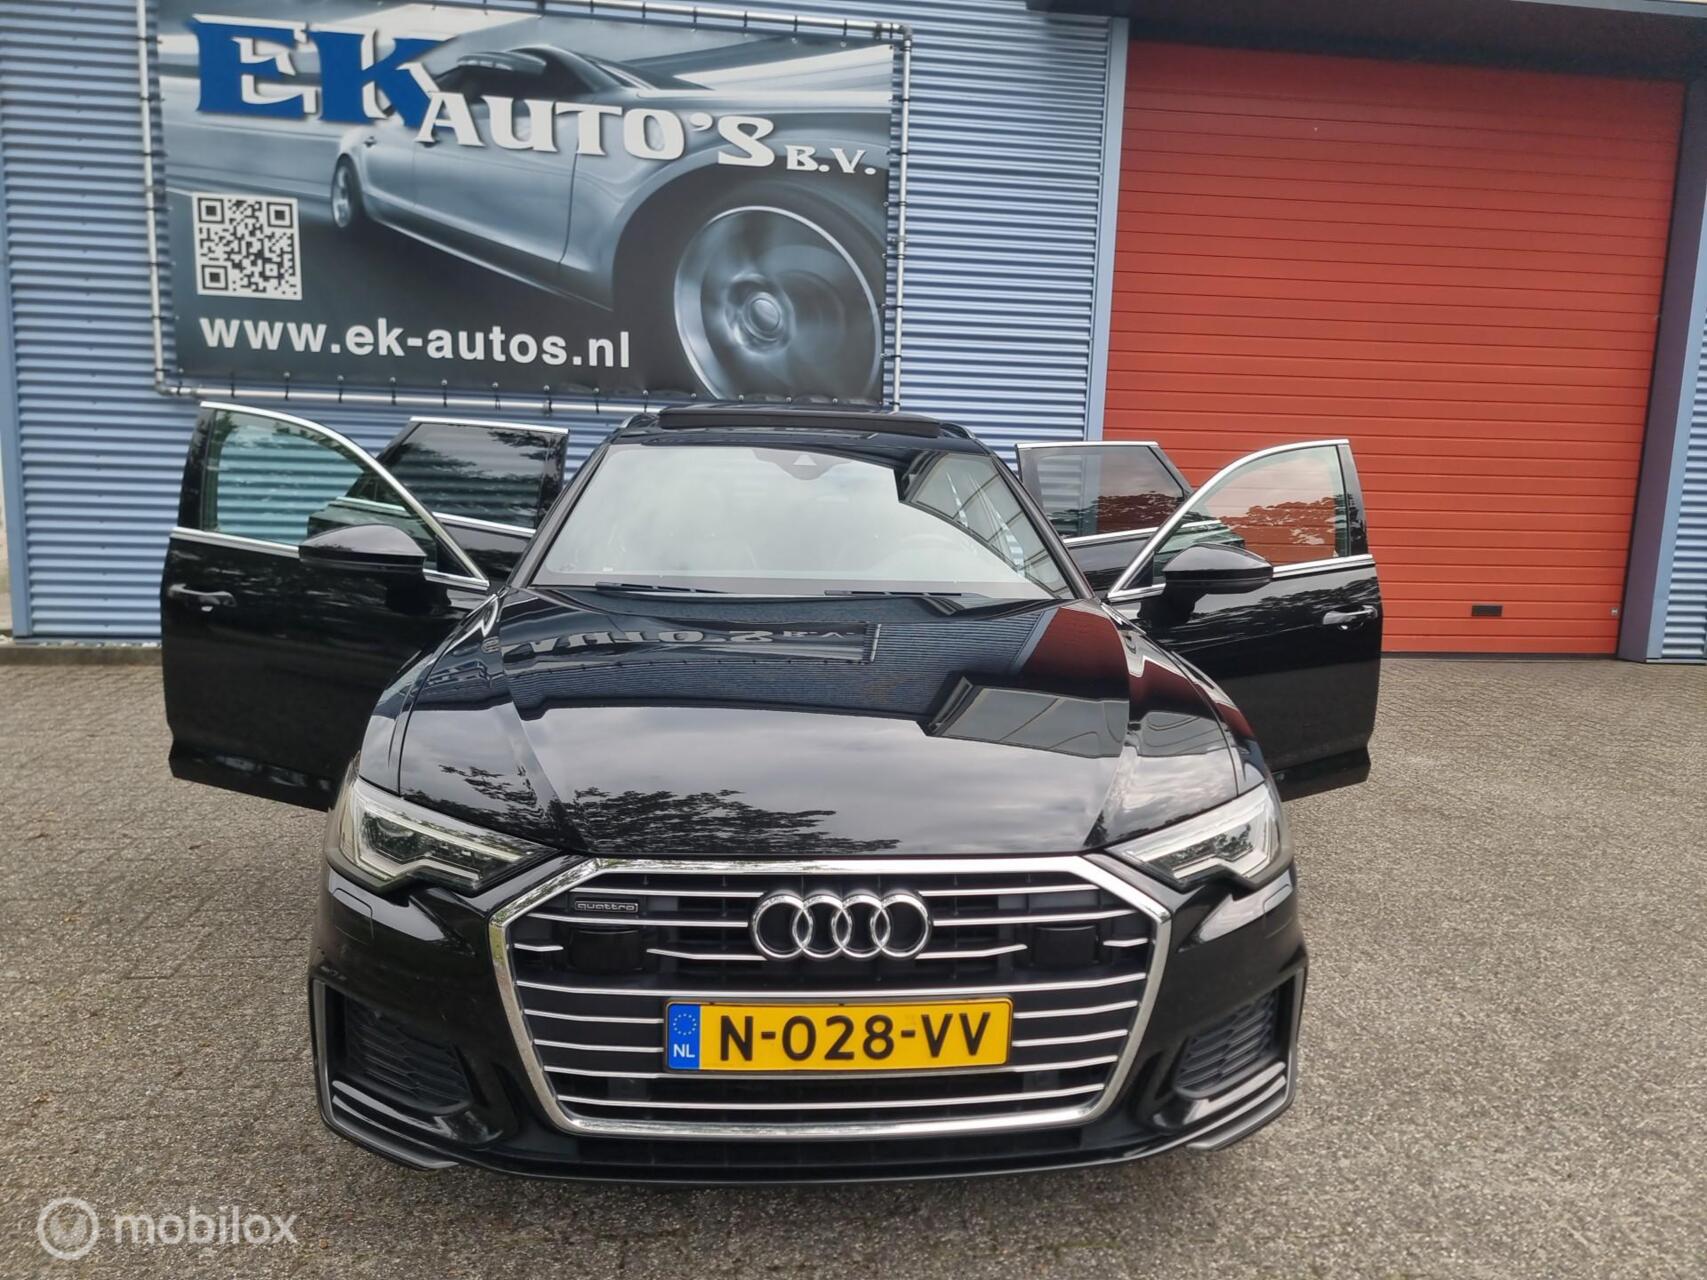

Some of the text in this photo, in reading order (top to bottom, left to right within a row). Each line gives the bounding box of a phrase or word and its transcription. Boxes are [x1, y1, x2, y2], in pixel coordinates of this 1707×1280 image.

[189, 15, 877, 176] EK AUTO'S B.V.
[200, 317, 630, 368] www.ek-autos.nl
[577, 903, 635, 911] quattro
[673, 1043, 695, 1058] NL
[720, 1011, 991, 1062] N-028-VV
